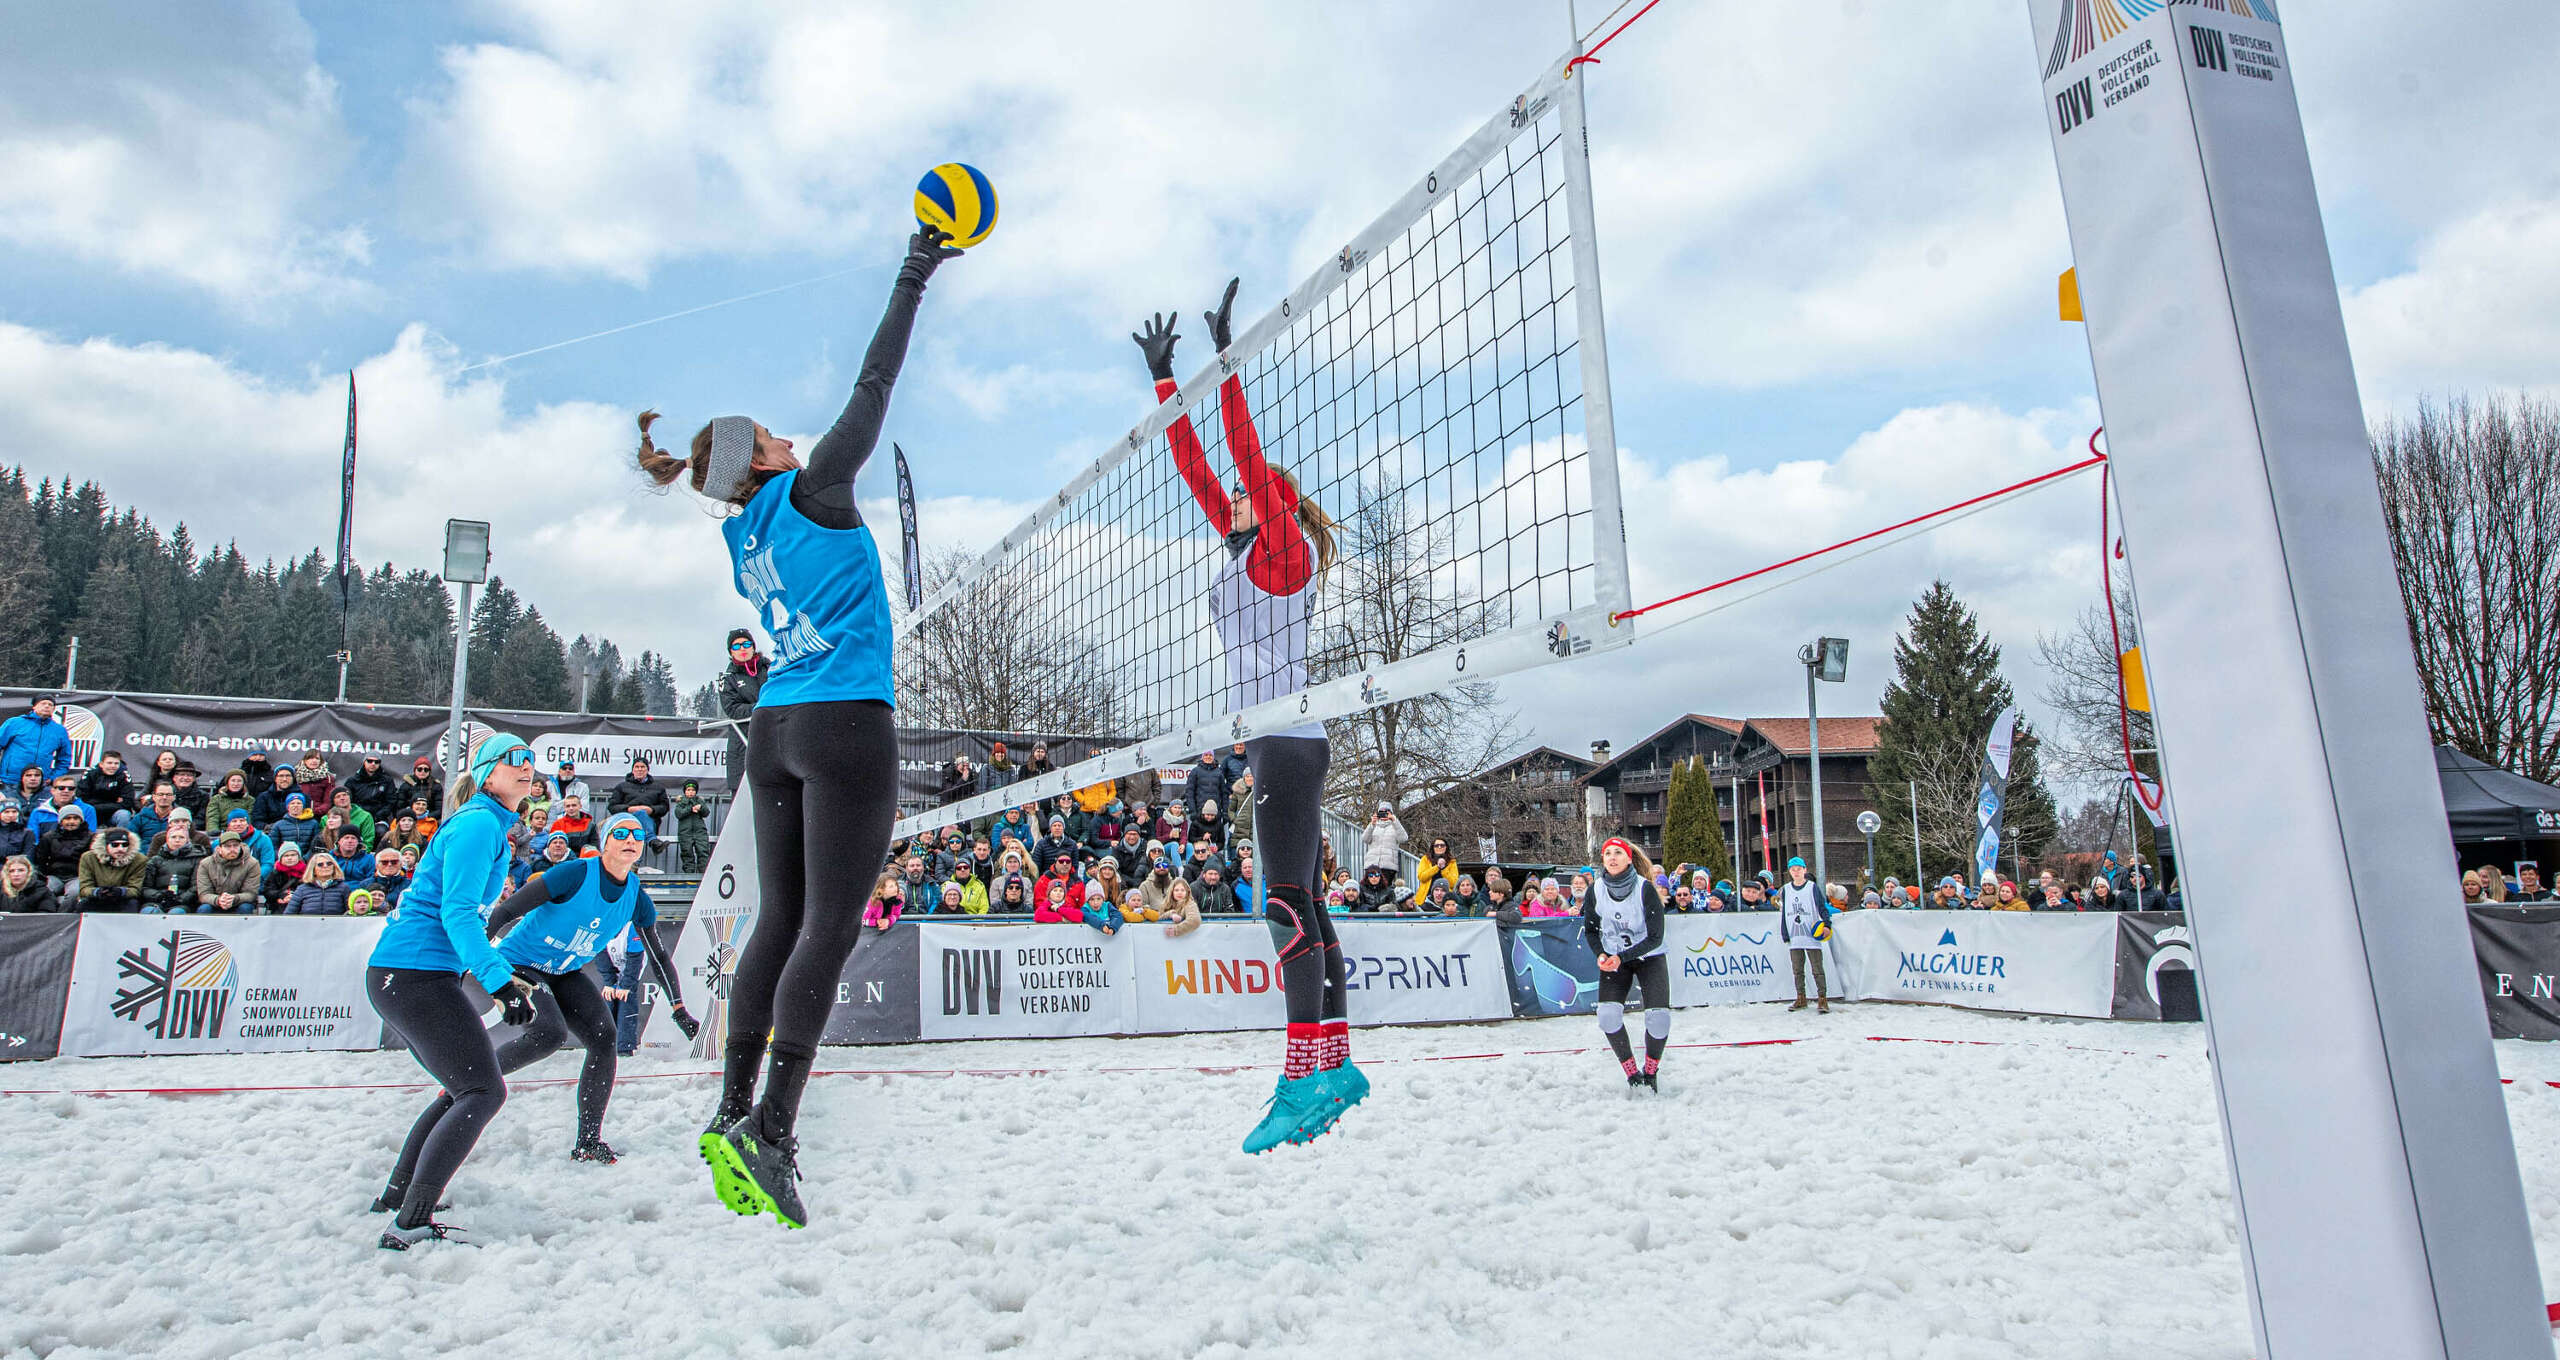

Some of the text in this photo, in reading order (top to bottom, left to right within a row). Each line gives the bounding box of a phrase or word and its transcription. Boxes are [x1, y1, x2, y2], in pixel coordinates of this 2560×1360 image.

[2189, 25, 2228, 72] DVV
[2228, 33, 2273, 53] DEUTSCHER
[2098, 38, 2153, 80] DEUTSCHER
[2231, 48, 2281, 69] VOLLEYBALL
[2101, 52, 2161, 94] VOLLEYBALL
[2234, 63, 2273, 82] VERBAND
[2103, 74, 2150, 109] VERBAND
[2055, 76, 2094, 135] DVV
[546, 745, 611, 765] GERMAN
[1017, 947, 1103, 966] DEUTSCHER
[1684, 954, 1775, 978] AQUARIA
[1896, 951, 2006, 979] ALLGÄUER
[942, 948, 1002, 1016] DVV
[1020, 969, 1110, 990] VOLLEYBALL
[1902, 979, 1995, 993] ALPENWASSER
[245, 988, 297, 1001] GERMAN
[1020, 995, 1091, 1015] VERBAND
[168, 989, 228, 1039] DVV
[242, 1005, 352, 1020] SNOWVOLLEYBALL
[240, 1024, 335, 1038] CHAMPIONSHIP
